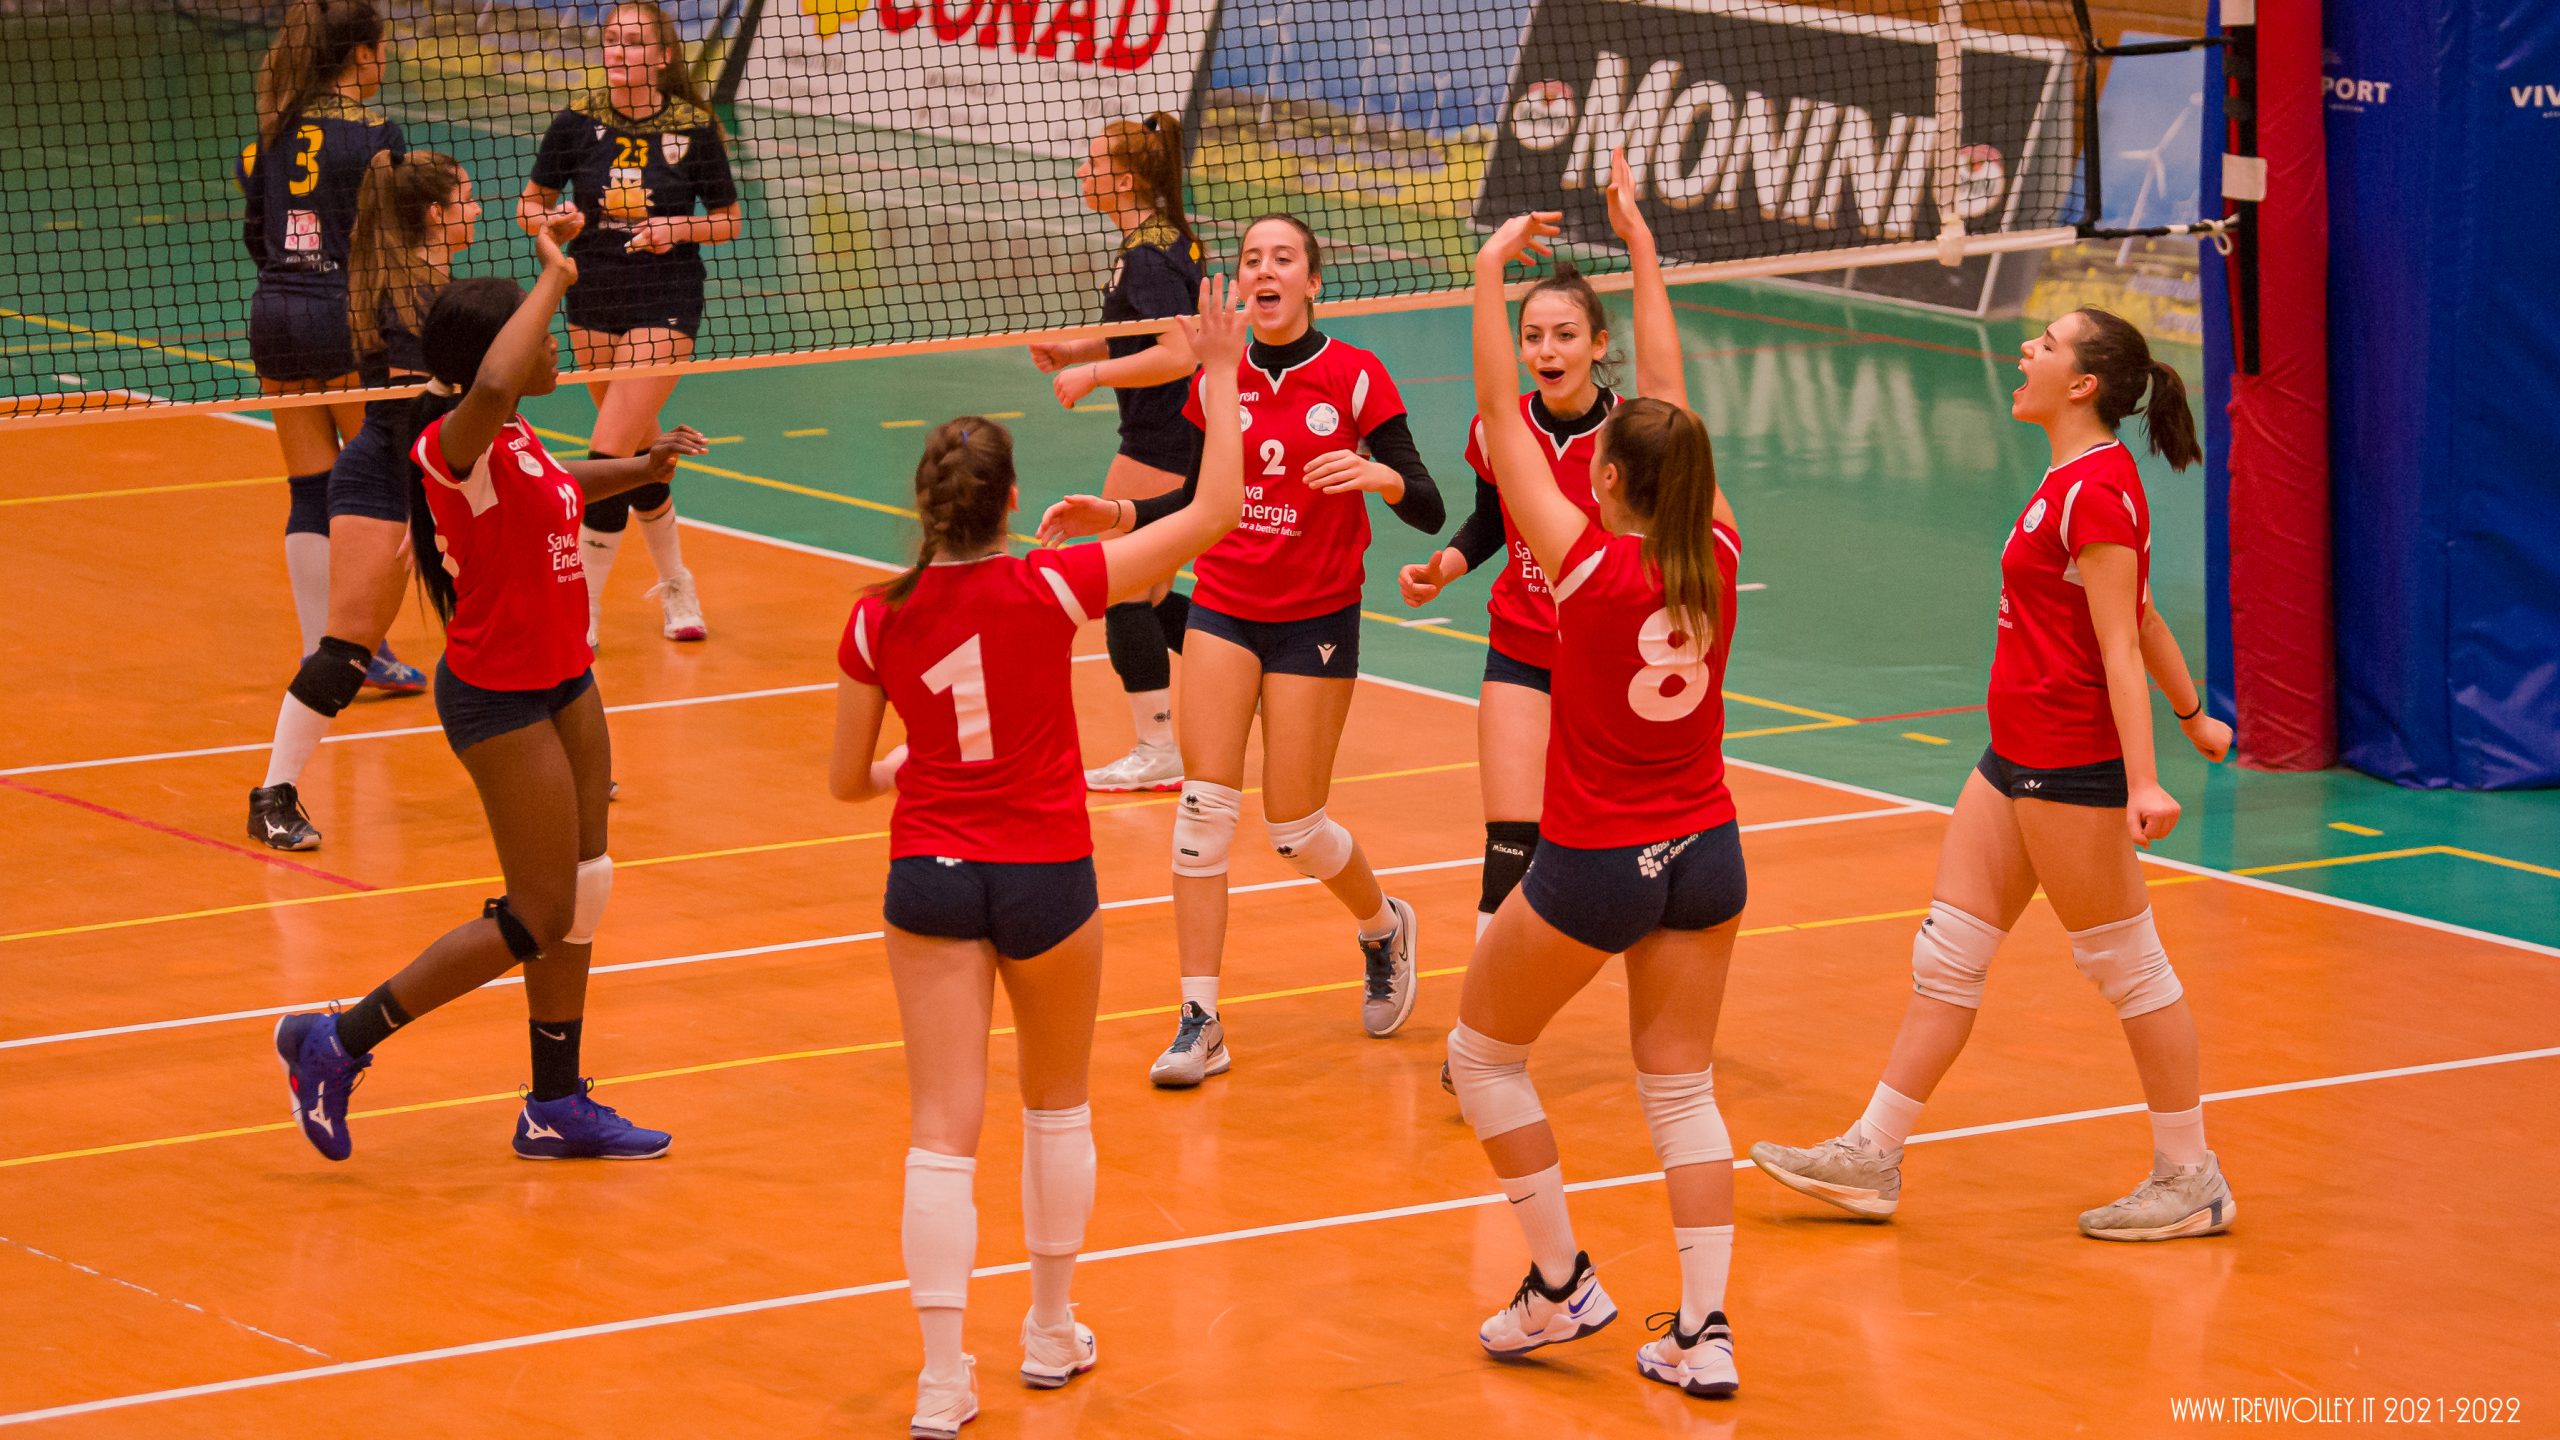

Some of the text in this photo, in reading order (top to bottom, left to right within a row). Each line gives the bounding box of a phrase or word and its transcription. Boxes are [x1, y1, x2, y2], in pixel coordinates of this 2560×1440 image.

[288, 124, 324, 197] 3
[611, 136, 648, 168] 23
[1559, 51, 1938, 238] MONINI
[1259, 439, 1286, 476] 2
[557, 483, 577, 520] 11
[1242, 503, 1297, 526] nergia
[1528, 582, 1540, 592] for
[1628, 604, 1712, 722] 8
[920, 633, 994, 762] 1
